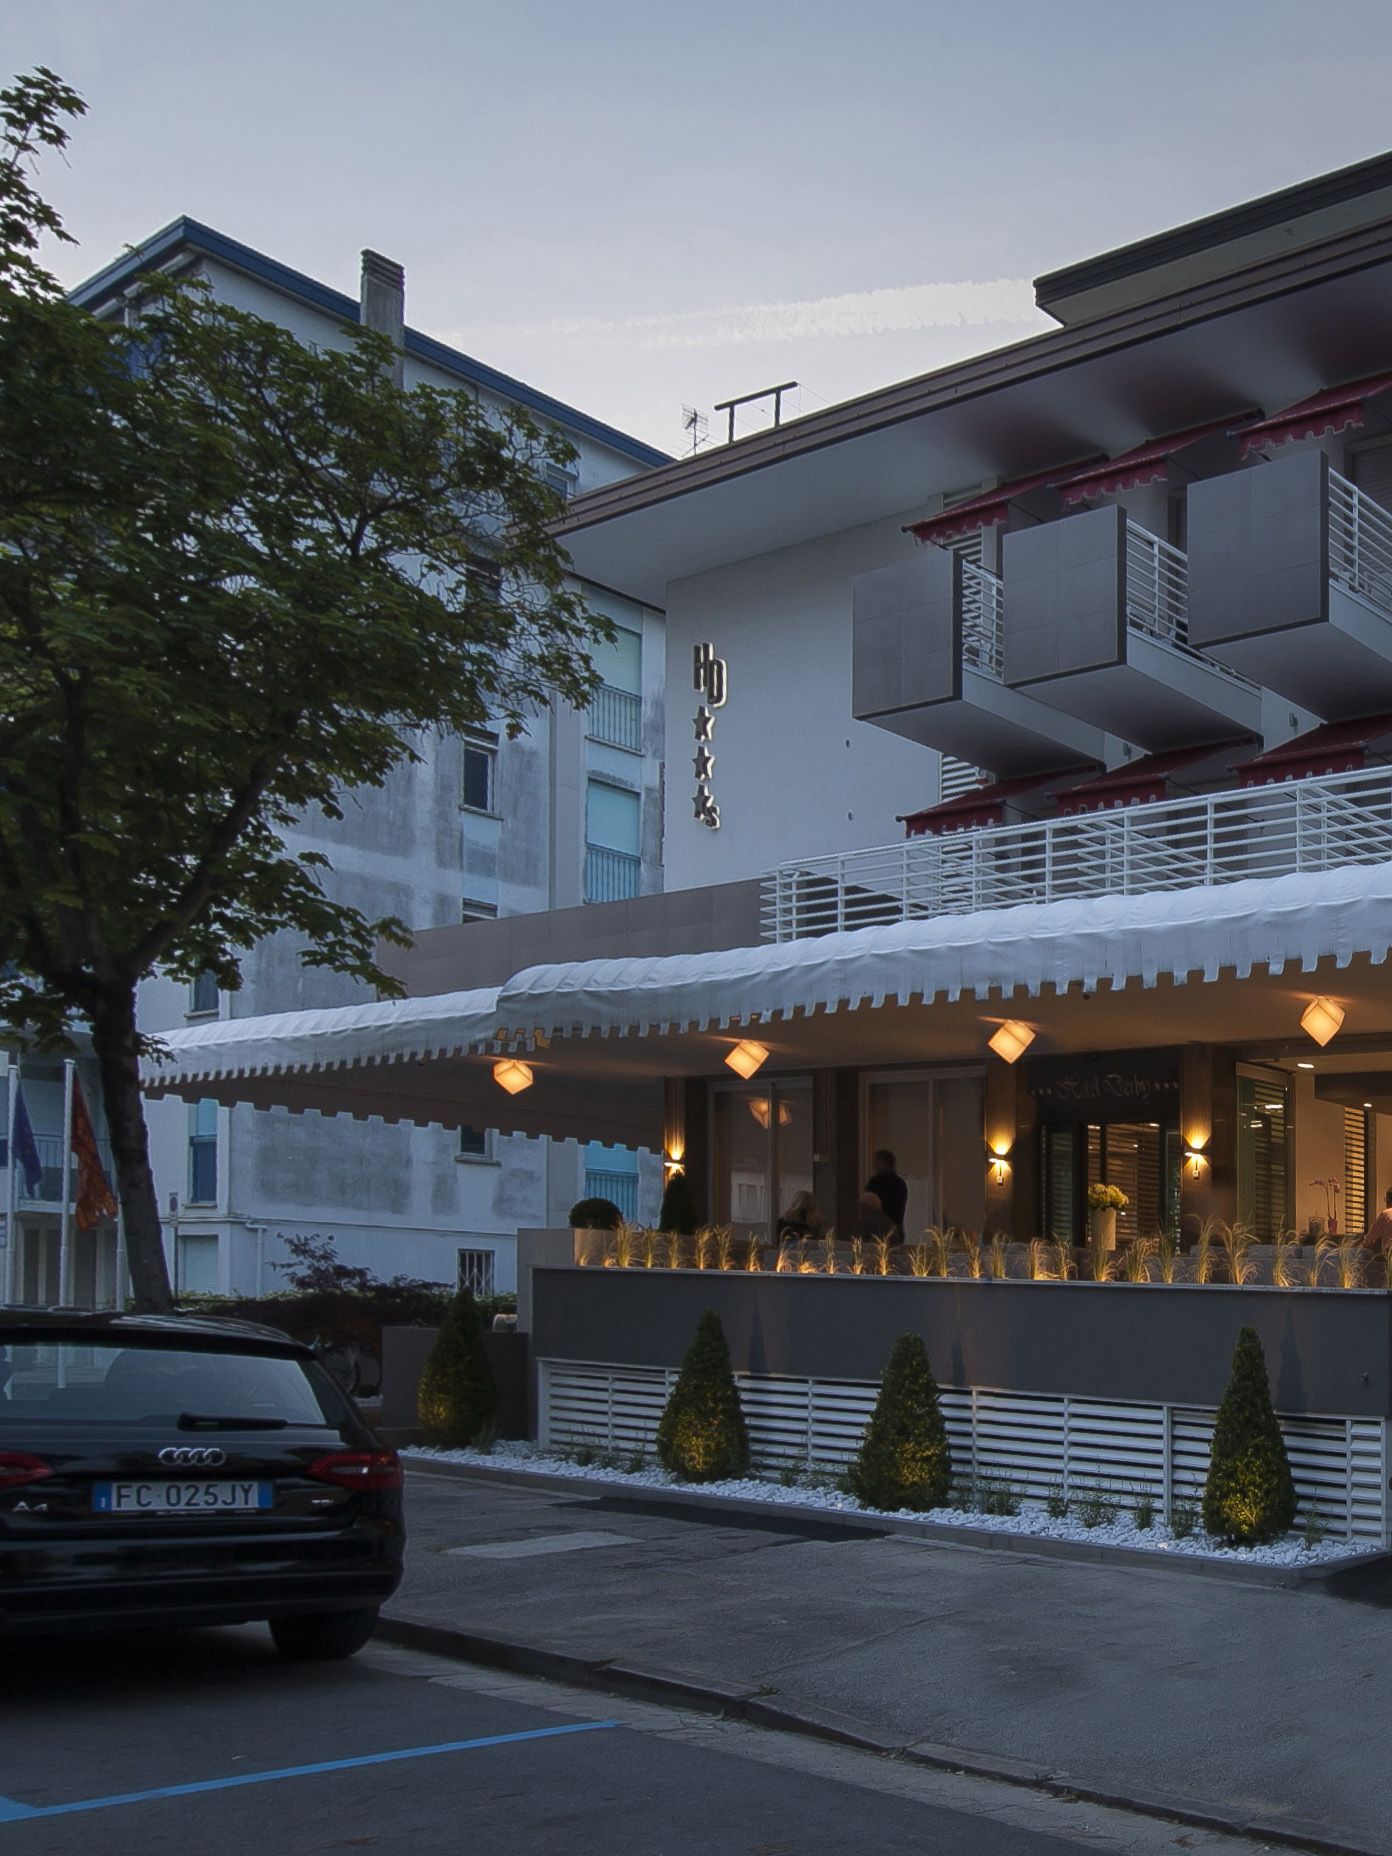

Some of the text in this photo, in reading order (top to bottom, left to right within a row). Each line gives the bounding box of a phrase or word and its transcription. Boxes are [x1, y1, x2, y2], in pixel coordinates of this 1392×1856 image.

[693, 642, 728, 708] HD
[1103, 1073, 1152, 1105] Derby
[12, 1500, 49, 1513] A4
